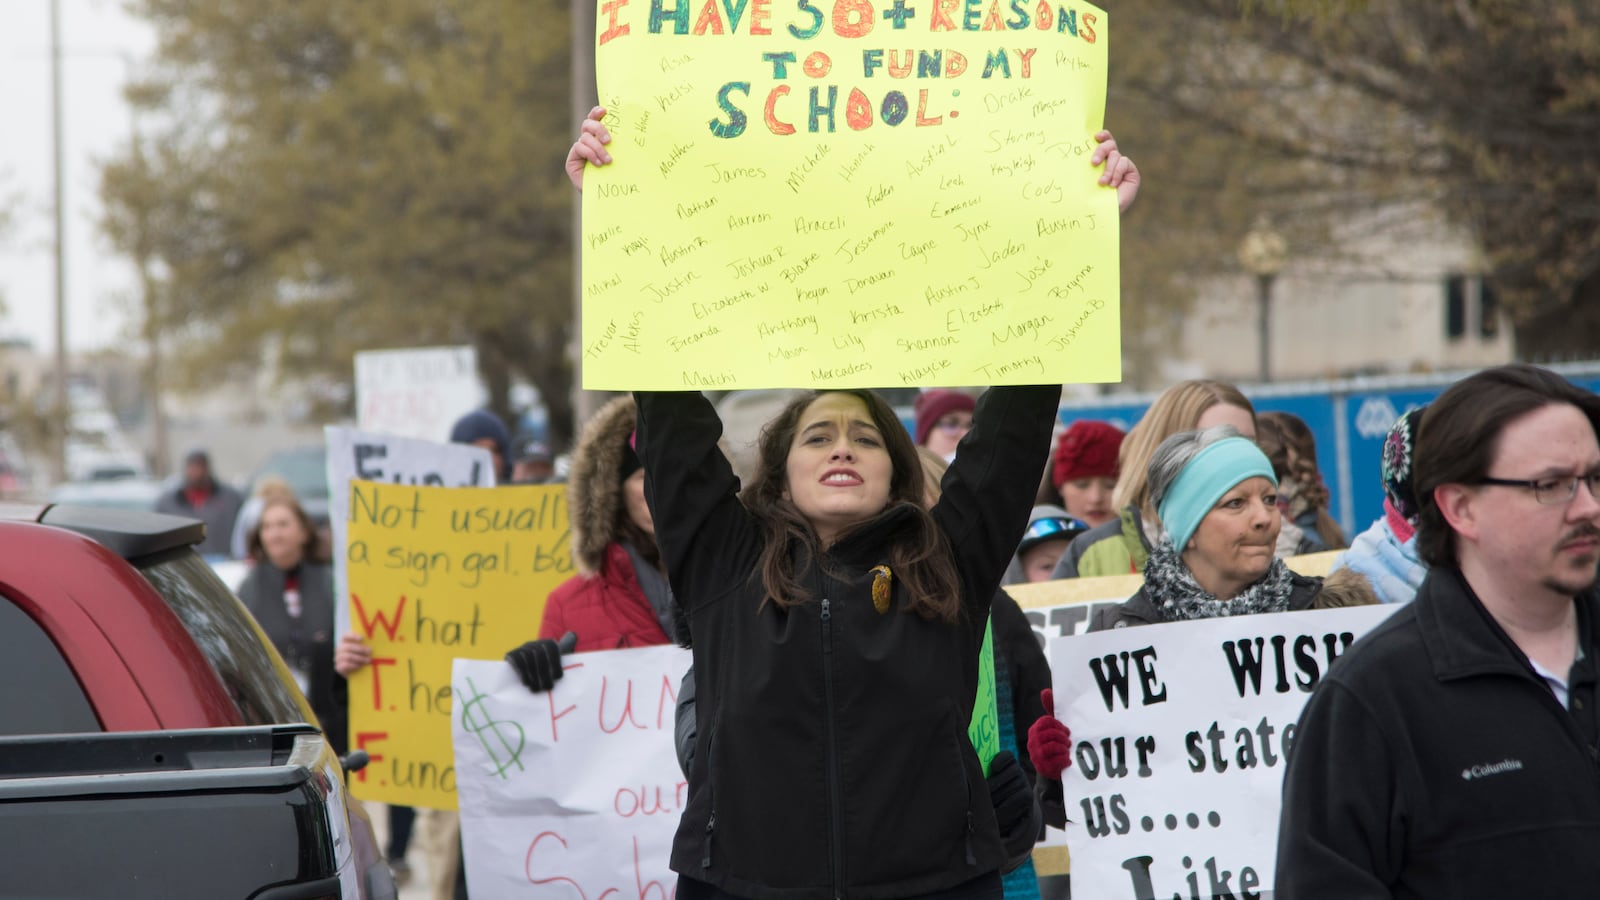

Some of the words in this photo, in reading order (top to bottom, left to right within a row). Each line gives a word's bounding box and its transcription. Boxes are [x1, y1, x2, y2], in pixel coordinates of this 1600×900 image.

[599, 0, 630, 46] I
[647, 0, 772, 36] HAVE
[930, 0, 1097, 44] REASONS
[658, 54, 694, 74] Asia
[762, 51, 832, 79] TO
[863, 48, 968, 79] FUND
[981, 47, 1038, 79] MY
[708, 81, 961, 139] SCHOOL:
[983, 86, 1033, 114] Drake
[984, 129, 1046, 153] Stormy
[704, 162, 767, 184] James
[786, 143, 831, 194] Michelle
[838, 142, 876, 183] Hannah
[905, 144, 947, 179] Austin
[1022, 180, 1063, 204] Cody
[676, 196, 719, 220] Nathan
[588, 225, 623, 250] Karlie
[794, 216, 847, 235] Araceli
[953, 220, 991, 242] Jynx
[1036, 218, 1081, 238] Austin
[659, 244, 697, 267] Austin
[898, 239, 938, 265] Zayne
[977, 239, 1026, 270] Jaden
[725, 254, 776, 280] Joshua
[780, 252, 821, 284] Blake
[1016, 256, 1054, 293] Josie
[639, 270, 702, 304] Justin
[842, 269, 897, 295] Donavan
[924, 281, 968, 306] Austin
[1048, 264, 1095, 299] Brynna
[691, 290, 756, 320] Elizabeth
[849, 302, 905, 325] Krista
[583, 319, 618, 359] Trevor
[757, 313, 819, 339] Anthony
[991, 314, 1055, 347] Morgan
[1046, 310, 1092, 352] Joshua
[832, 334, 866, 352] Lily
[896, 335, 960, 353] Shannon
[973, 355, 1045, 380] Timothy
[351, 485, 424, 529] Not
[348, 540, 370, 566] a
[384, 546, 450, 588] sign
[1088, 645, 1168, 713] WE
[1076, 734, 1156, 781] our
[1471, 759, 1523, 778] Columbia
